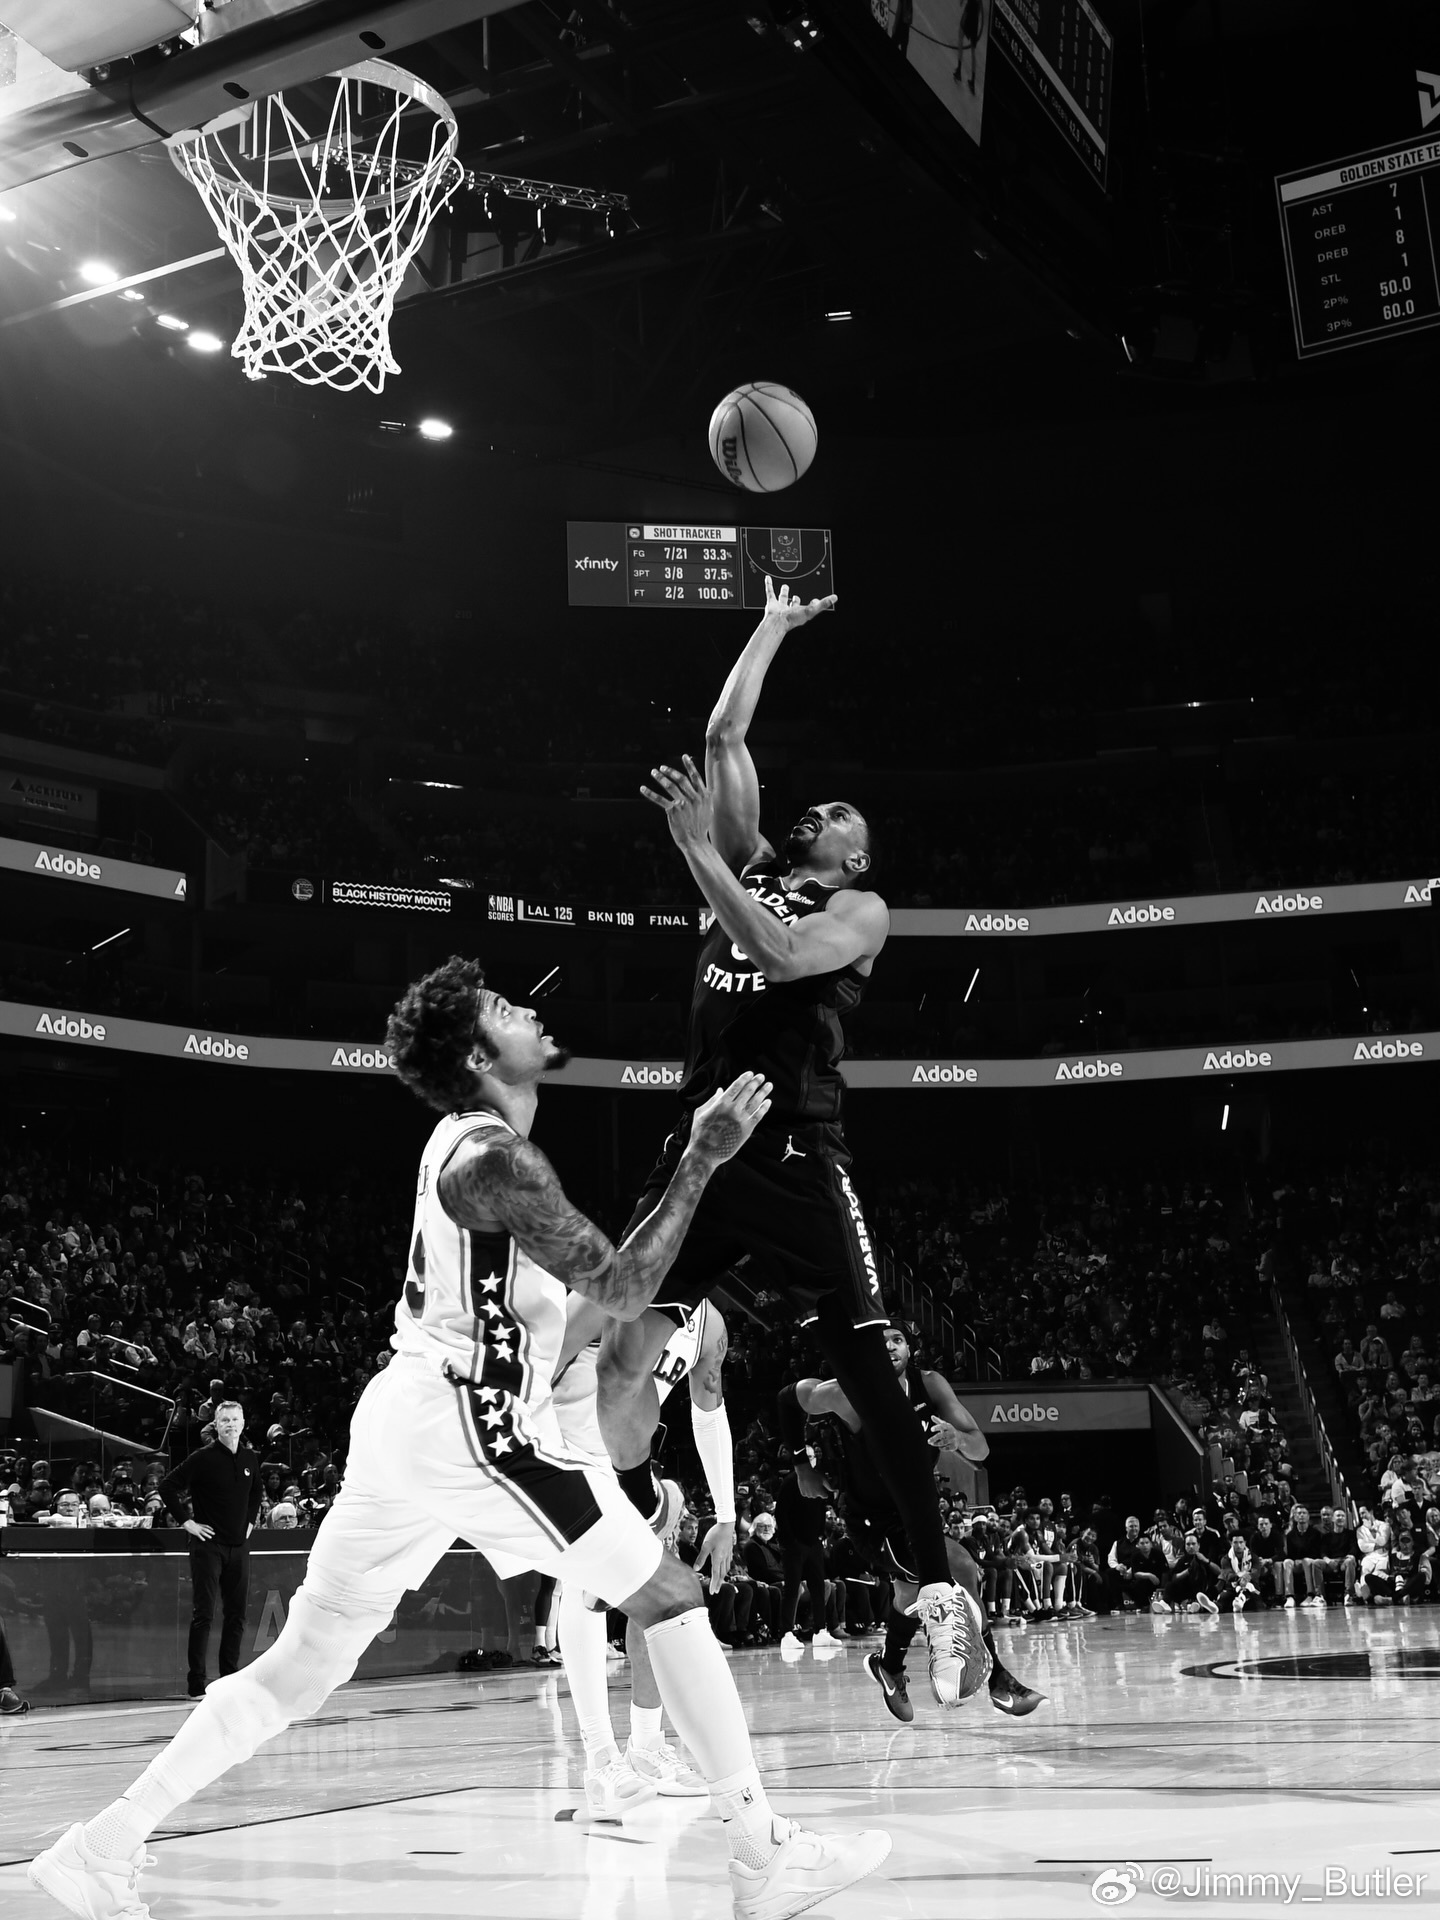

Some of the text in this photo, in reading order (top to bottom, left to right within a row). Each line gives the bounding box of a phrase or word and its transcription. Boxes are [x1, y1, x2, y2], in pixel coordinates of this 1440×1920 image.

[1340, 160, 1385, 183] GOLDEN
[1388, 149, 1424, 170] STATE
[1312, 183, 1398, 217] AST 7
[1314, 206, 1402, 240] OREB 1
[1317, 229, 1405, 263] DREB 8
[1321, 252, 1408, 286] STL 1
[1323, 276, 1412, 309] 2P% 50.0
[1326, 299, 1415, 332] 3P% 60.0
[653, 527, 722, 540] SHOT TRACKER
[575, 556, 619, 572] xfinity
[633, 549, 645, 558] FG
[664, 547, 688, 560] 7/21
[633, 569, 650, 577] 3PT
[664, 567, 683, 580] 3/8
[634, 589, 645, 597] FT
[665, 587, 685, 600] 2/2
[35, 851, 101, 880] Adobe
[332, 888, 451, 908] BLACK HISTORY MONTH
[496, 895, 514, 913] NBA
[1255, 893, 1323, 914] Adobe
[488, 911, 514, 922] SCORES
[528, 905, 549, 917] LAL
[554, 906, 573, 920] 125
[588, 910, 613, 922] BKN
[616, 912, 634, 926] 109
[649, 915, 689, 927] FINAL
[964, 914, 1030, 931] Adobe
[1107, 904, 1175, 925] Adobe
[703, 963, 767, 993] STATE
[36, 1013, 106, 1041] Adobe
[184, 1034, 249, 1060] Adobe
[1353, 1039, 1424, 1060] Adobe
[1055, 1059, 1123, 1080] Adobe
[1203, 1049, 1272, 1070] Adobe
[912, 1065, 977, 1083] Adobe
[990, 1403, 1059, 1423] Adobe
